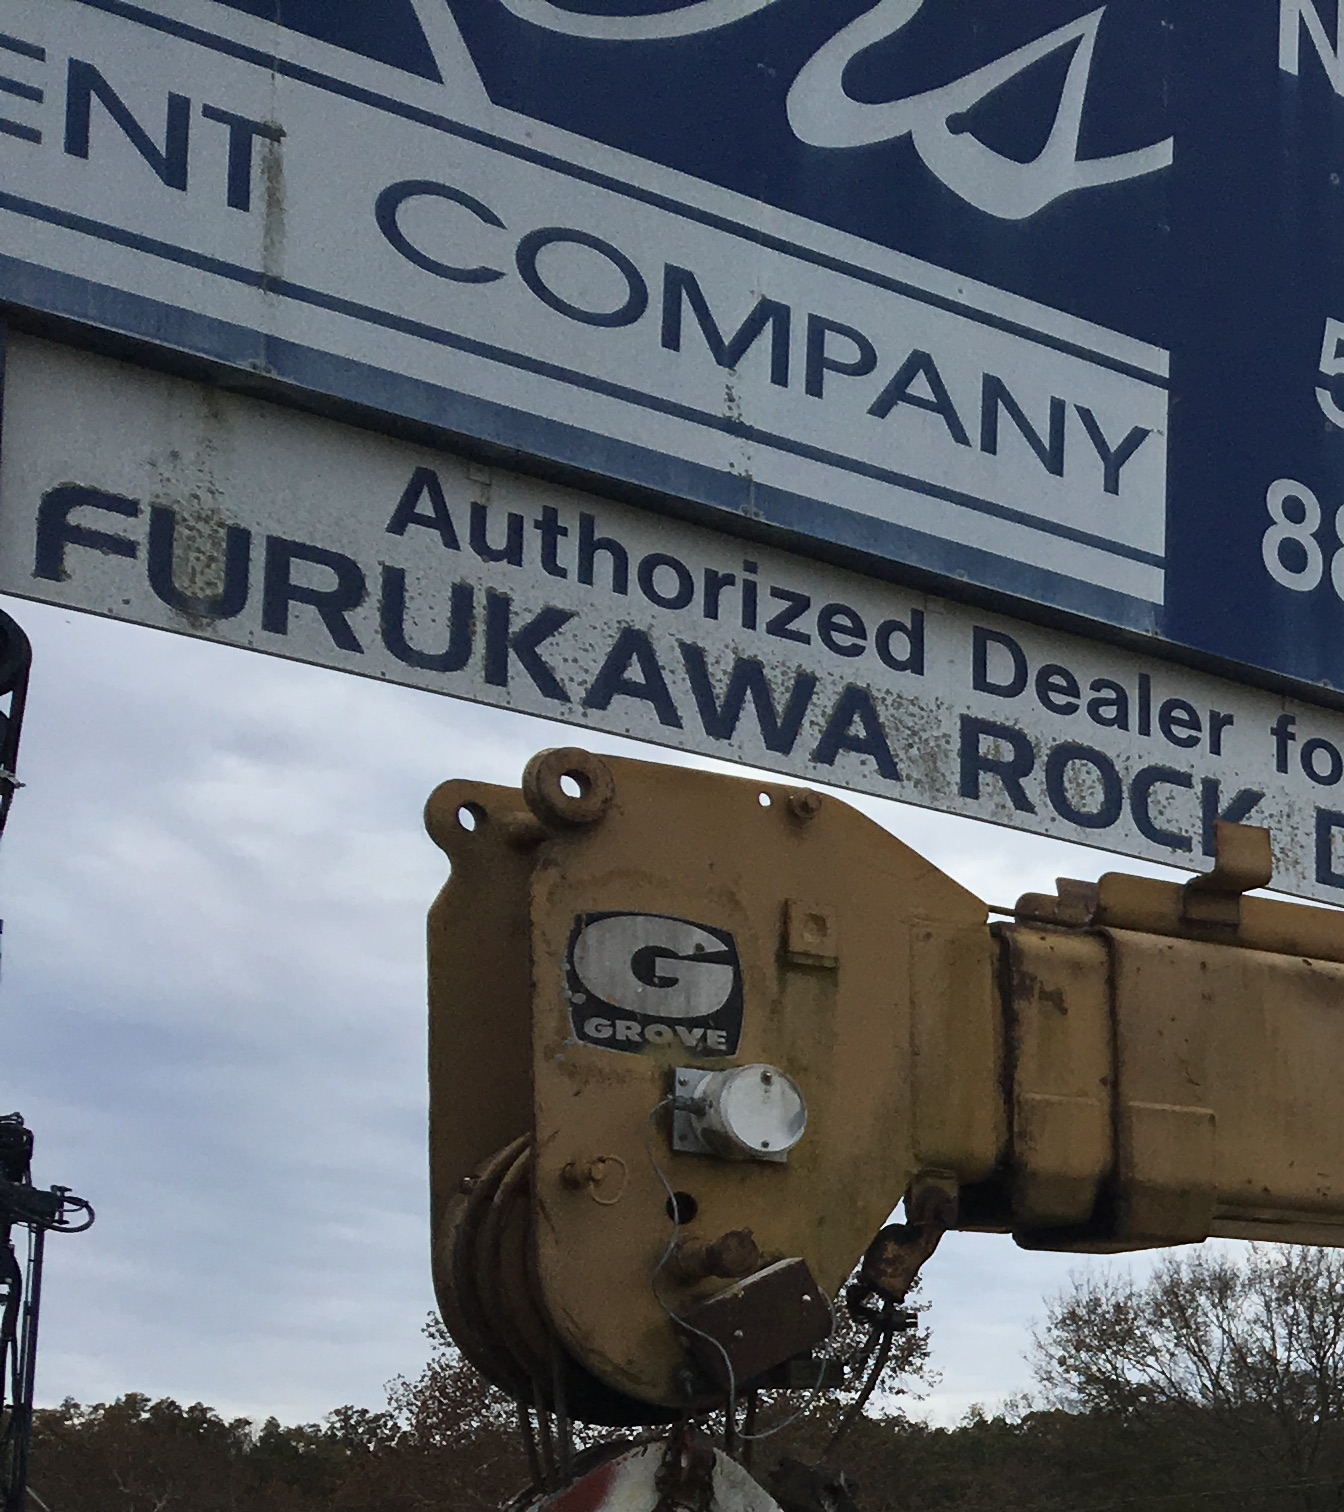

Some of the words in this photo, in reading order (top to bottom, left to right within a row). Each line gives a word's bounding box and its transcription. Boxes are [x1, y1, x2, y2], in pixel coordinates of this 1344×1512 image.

[375, 179, 1151, 494] COMPANY
[33, 483, 902, 781] FURUKAWA
[959, 714, 1265, 858] ROCK
[387, 467, 925, 676] Authorized
[972, 627, 1233, 757] Dealer
[573, 915, 734, 1018] G
[584, 1016, 727, 1050] GROVE
